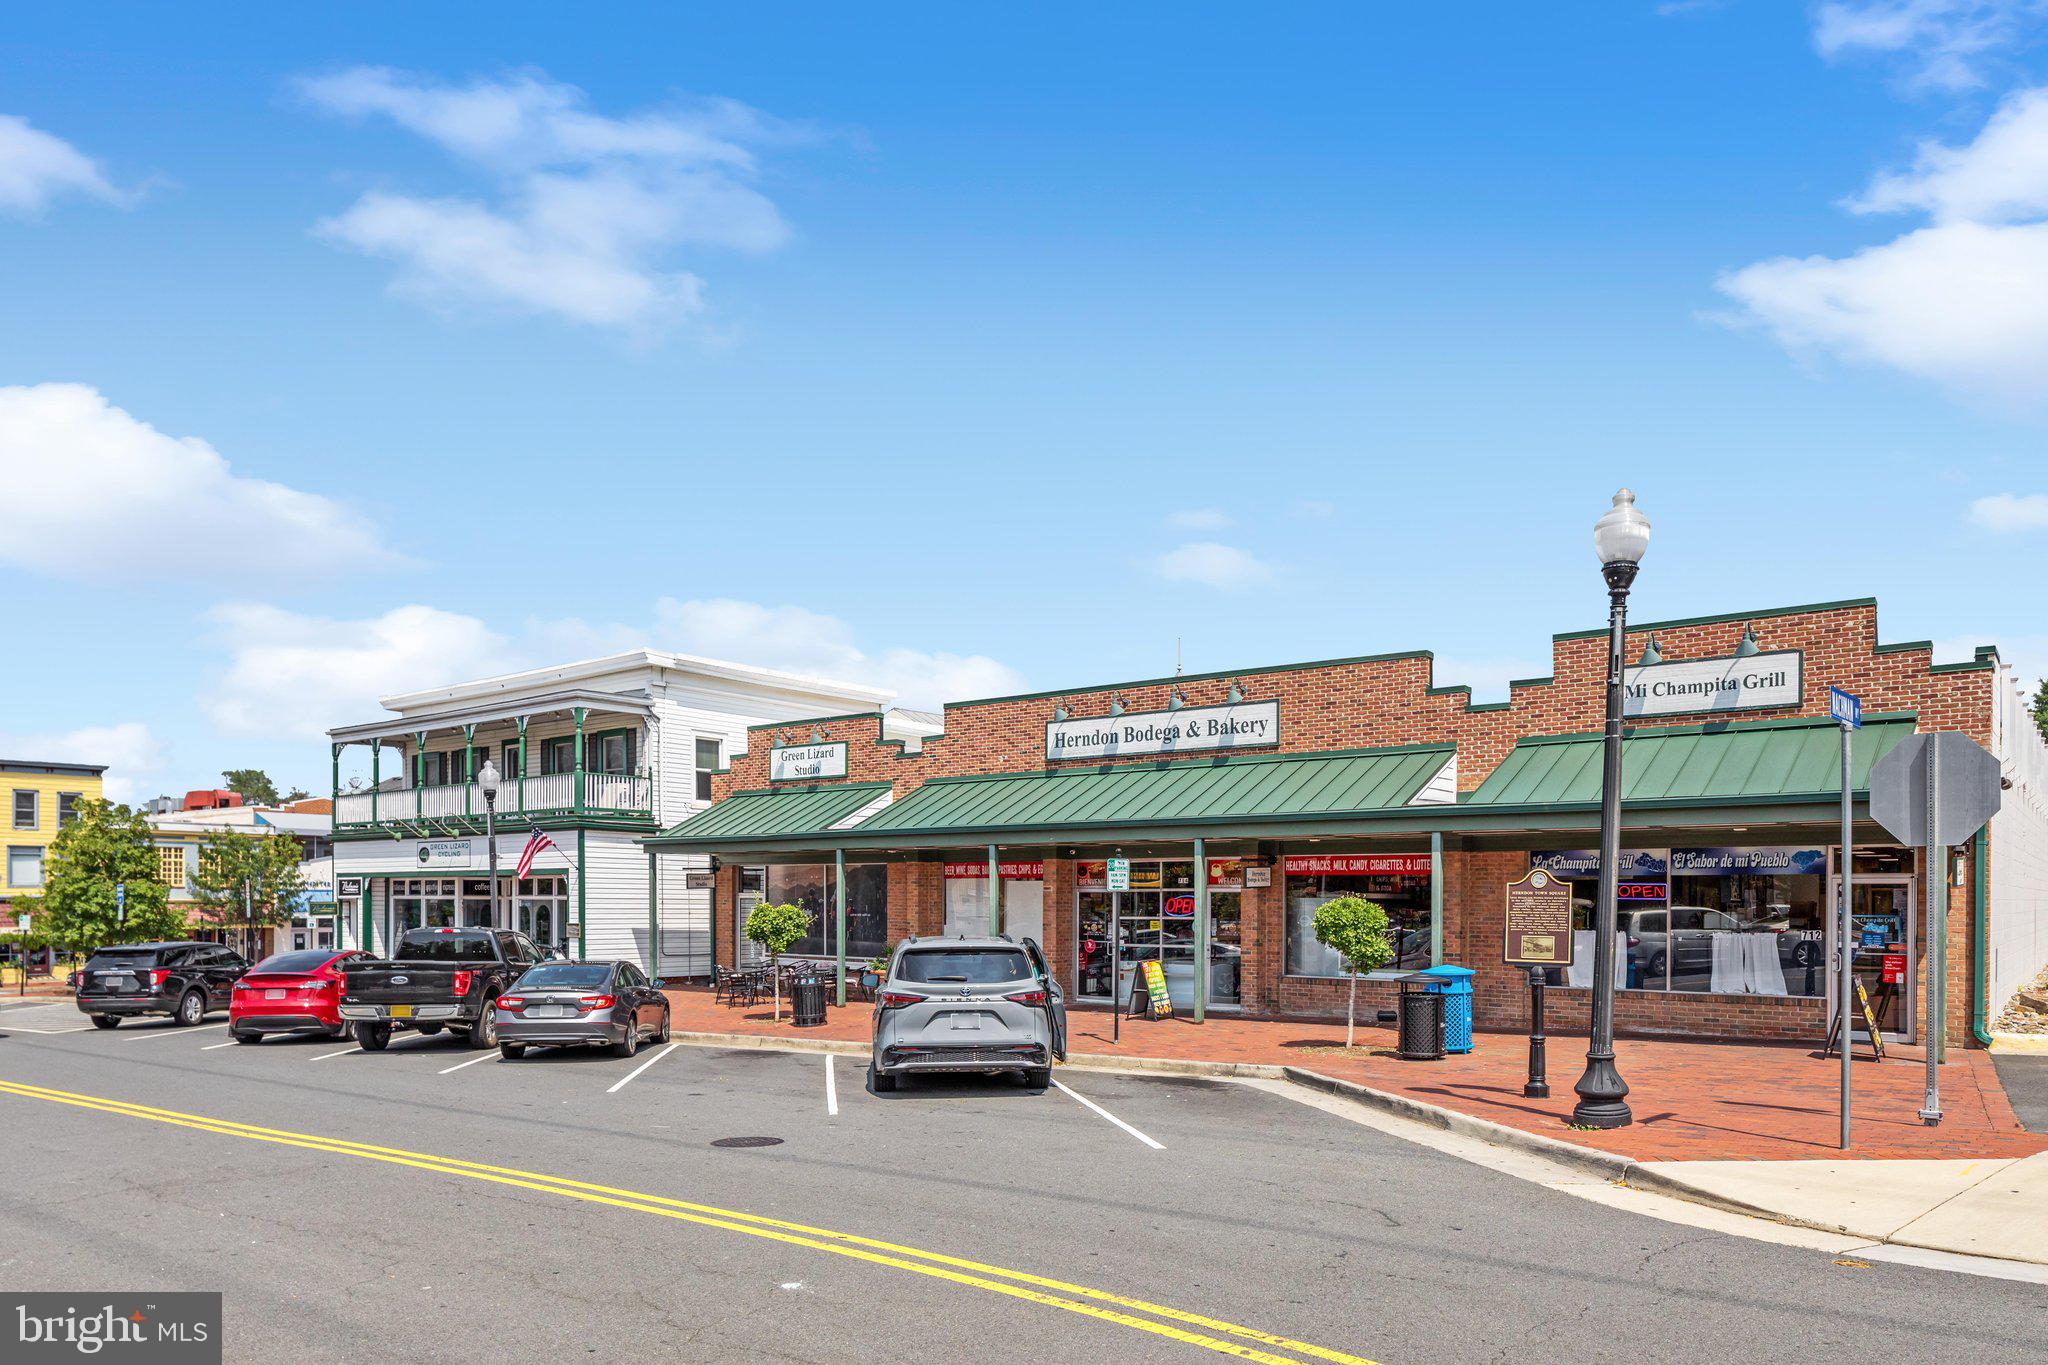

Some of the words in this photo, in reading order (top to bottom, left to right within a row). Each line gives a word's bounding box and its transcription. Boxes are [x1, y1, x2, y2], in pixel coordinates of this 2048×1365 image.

[1625, 684, 1647, 699] Mi
[1653, 677, 1737, 697] Champita
[1743, 671, 1786, 689] Grill
[1054, 730, 1118, 749] Herndon
[1124, 724, 1180, 744] Bodega
[1187, 720, 1201, 738] &
[1207, 718, 1268, 737] Bakery
[781, 750, 805, 762] Green
[807, 747, 834, 760] Lizard
[794, 764, 820, 776] Studio
[1285, 859, 1308, 871] HEALTHY
[1406, 858, 1412, 870] &
[1413, 859, 1431, 870] LOTTE
[1532, 855, 1548, 869] La
[1673, 853, 1685, 868] El
[1686, 852, 1718, 869] Sabor
[1720, 852, 1733, 867] de
[1735, 852, 1749, 867] mi
[1751, 851, 1789, 868] Pueblo
[475, 883, 490, 891] coffee
[1618, 885, 1666, 898] OPEN
[1166, 897, 1194, 913] OPEN
[1802, 930, 1821, 940] 712
